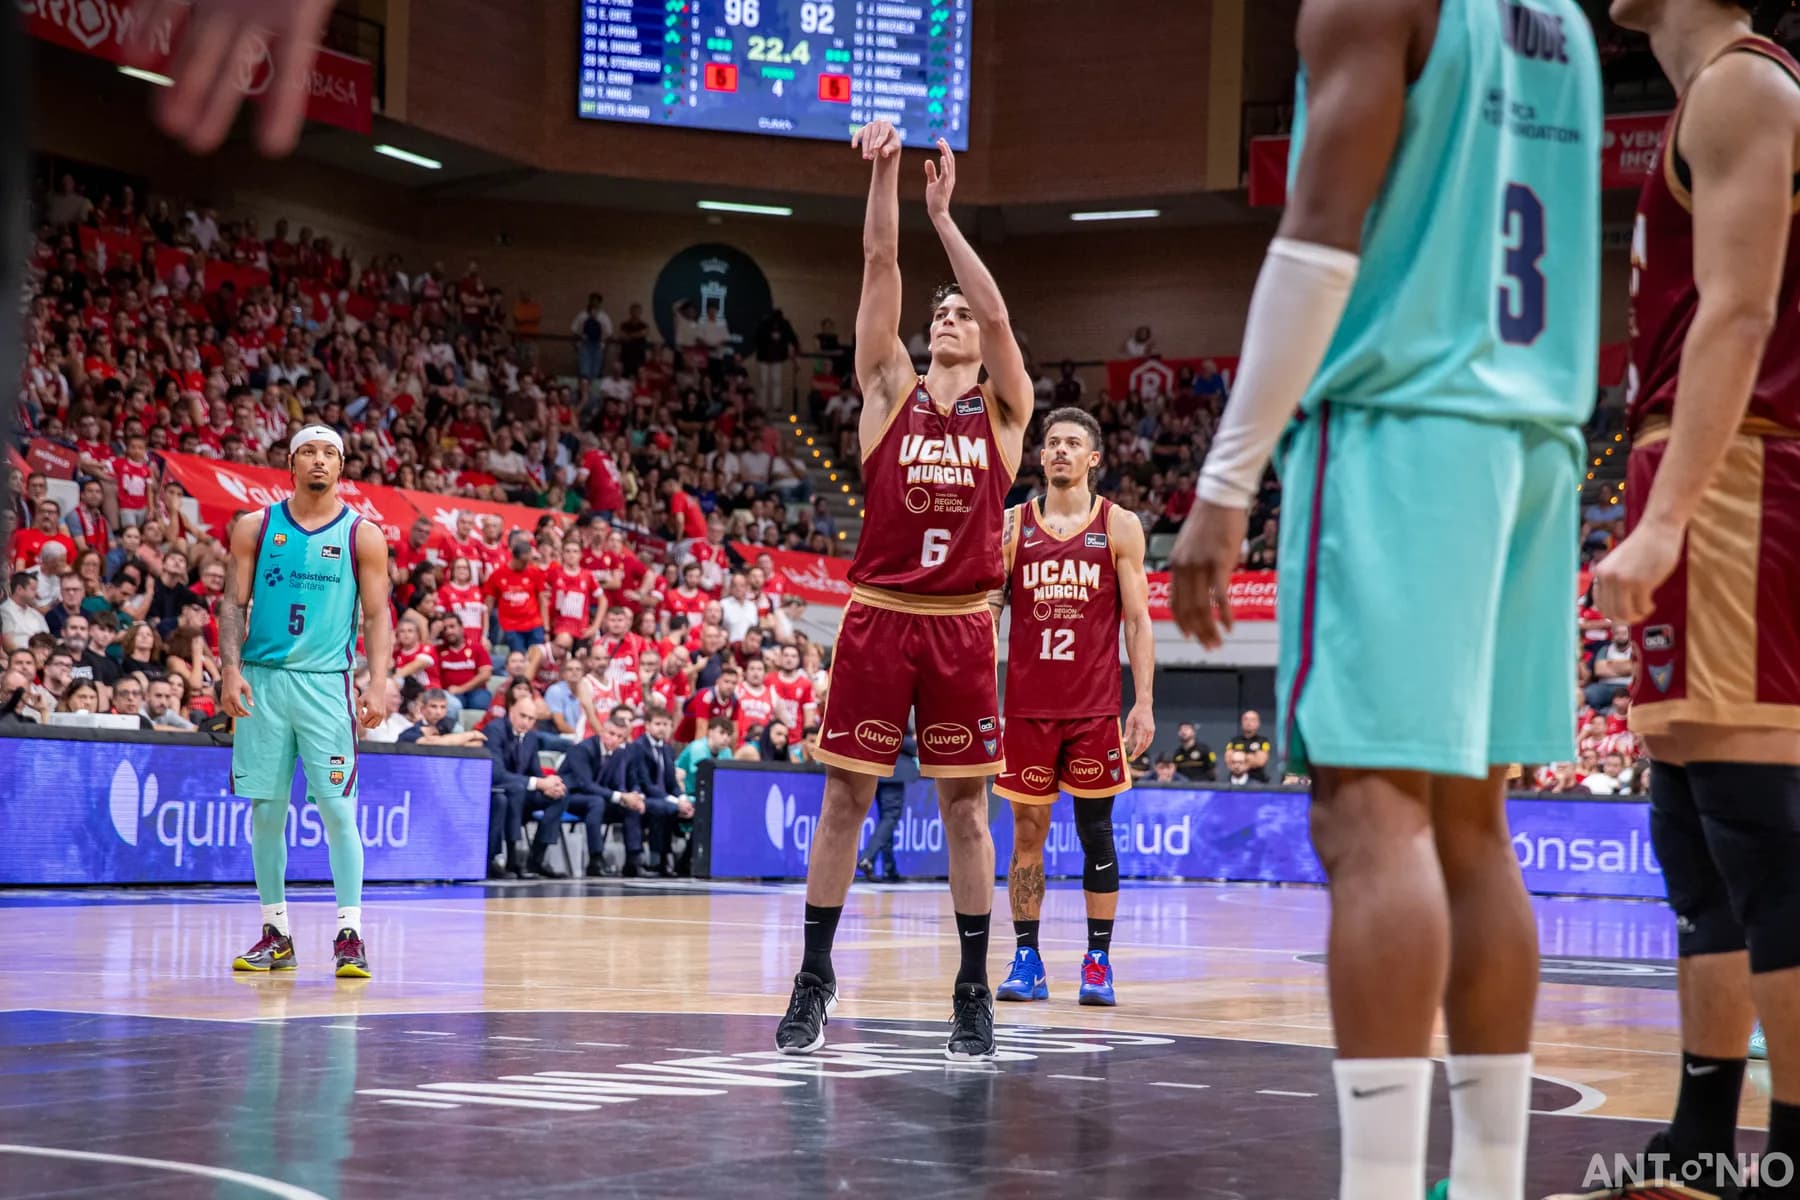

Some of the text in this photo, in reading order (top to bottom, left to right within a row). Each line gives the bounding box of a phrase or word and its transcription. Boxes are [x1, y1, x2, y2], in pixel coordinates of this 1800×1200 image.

[725, 0, 760, 28] 96
[801, 2, 835, 35] 92
[747, 35, 811, 65] 22.4
[715, 69, 727, 87] 5
[771, 79, 784, 98] 4
[829, 79, 840, 97] 5
[1498, 182, 1546, 347] 3
[898, 433, 990, 471] UCAM
[906, 465, 976, 488] MURCIA
[920, 528, 952, 568] 6
[1022, 559, 1101, 590] UCAM
[1033, 584, 1090, 602] MURCIA
[288, 604, 306, 636] 5
[1040, 628, 1075, 660] 12
[860, 717, 900, 747] Juver
[927, 733, 967, 745] Juver
